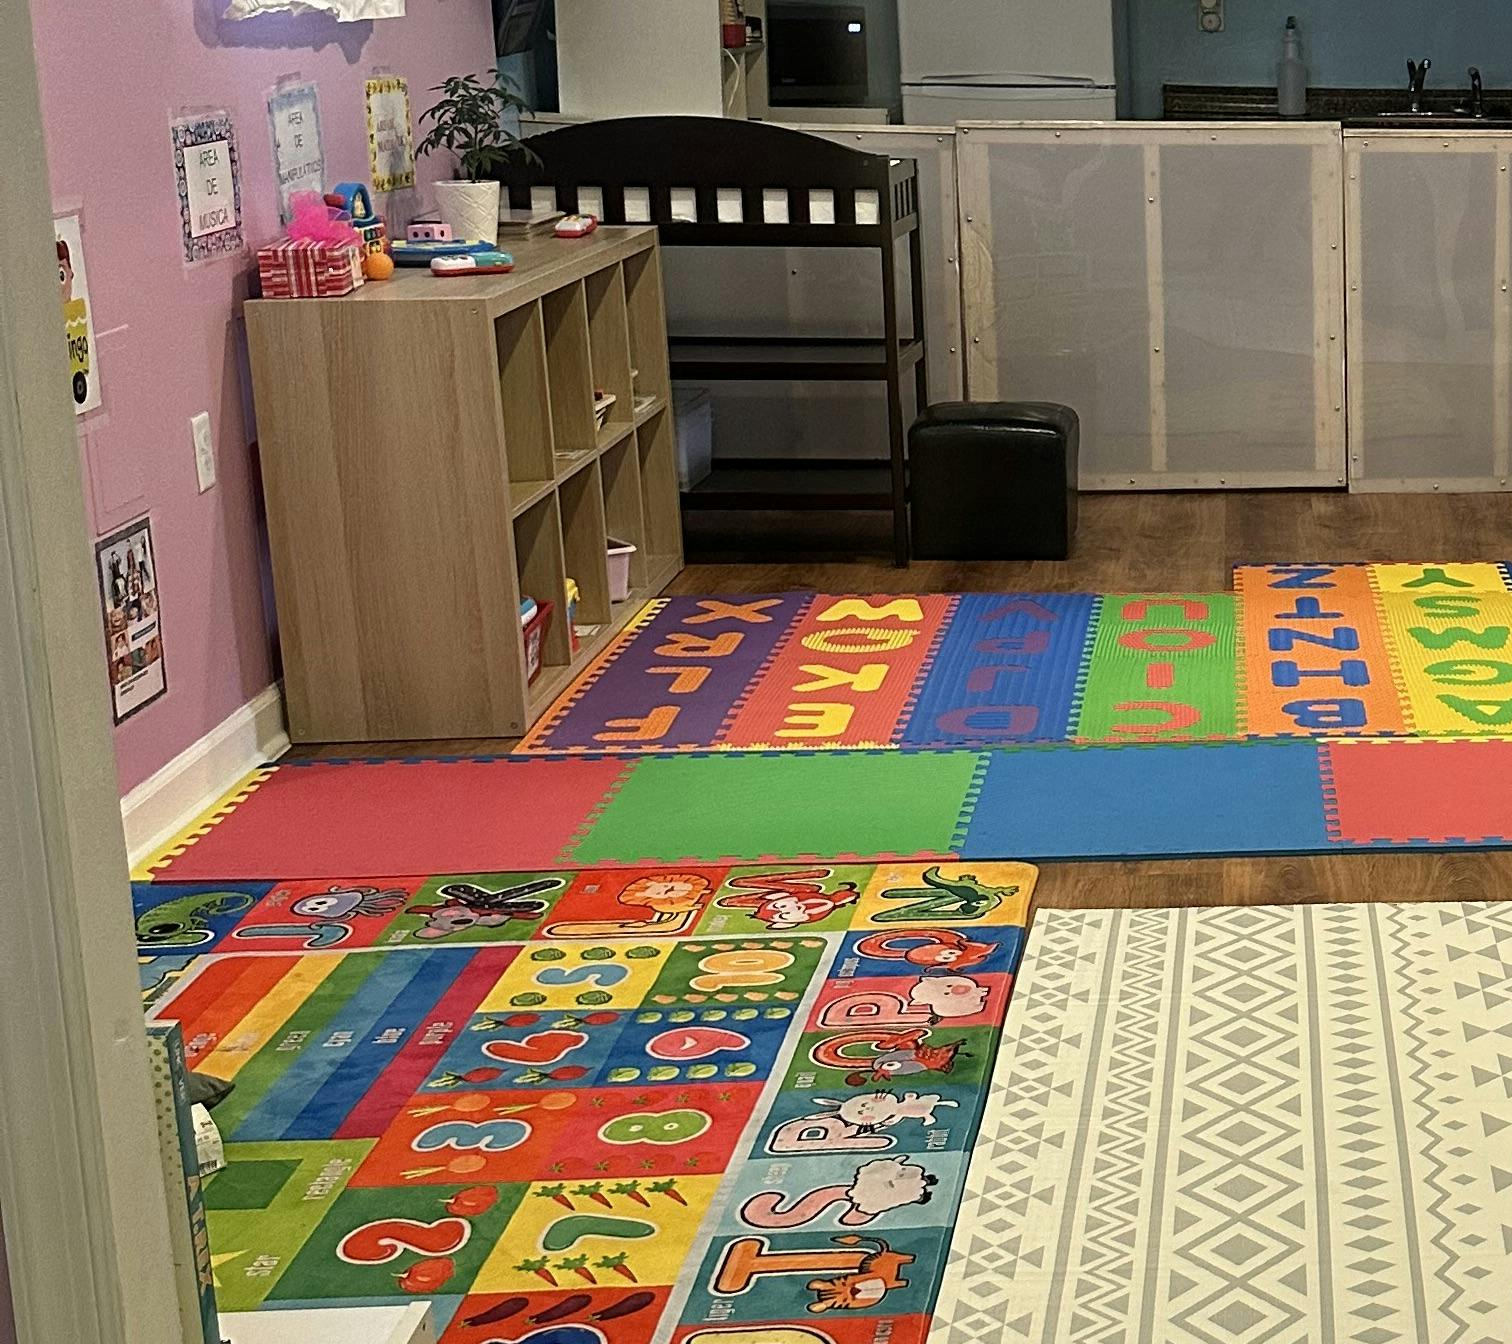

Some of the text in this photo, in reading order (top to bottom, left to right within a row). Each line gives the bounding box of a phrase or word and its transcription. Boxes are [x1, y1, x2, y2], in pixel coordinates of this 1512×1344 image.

[206, 177, 219, 196] DE
[681, 598, 785, 624] X
[1274, 596, 1345, 619] T
[1413, 595, 1483, 618] S
[654, 631, 746, 657] R
[801, 627, 921, 653] Q
[973, 630, 1052, 654] P
[1118, 627, 1218, 653] O
[645, 665, 712, 694] L
[791, 663, 891, 692] K
[966, 664, 1032, 693] J
[1146, 662, 1174, 689] I
[1271, 660, 1371, 687] H
[593, 705, 682, 742] F
[774, 702, 856, 739] E
[935, 704, 1041, 737] D
[1111, 701, 1202, 735] C
[1281, 698, 1368, 729] B
[531, 962, 635, 990] 5
[689, 949, 798, 992] 10
[816, 991, 937, 1030] P
[371, 1027, 407, 1046] blue
[418, 1022, 455, 1047] purple
[482, 1028, 590, 1066] 4
[645, 1026, 753, 1061] 9
[809, 1028, 933, 1071] Q
[411, 1118, 533, 1153] 3
[598, 1108, 713, 1146] 8
[764, 1114, 899, 1156] R
[736, 1184, 881, 1229] S
[335, 1216, 472, 1266] 2
[536, 1213, 661, 1255] 7
[243, 1253, 281, 1278] star
[707, 1234, 879, 1297] T
[703, 1297, 736, 1323] tiger
